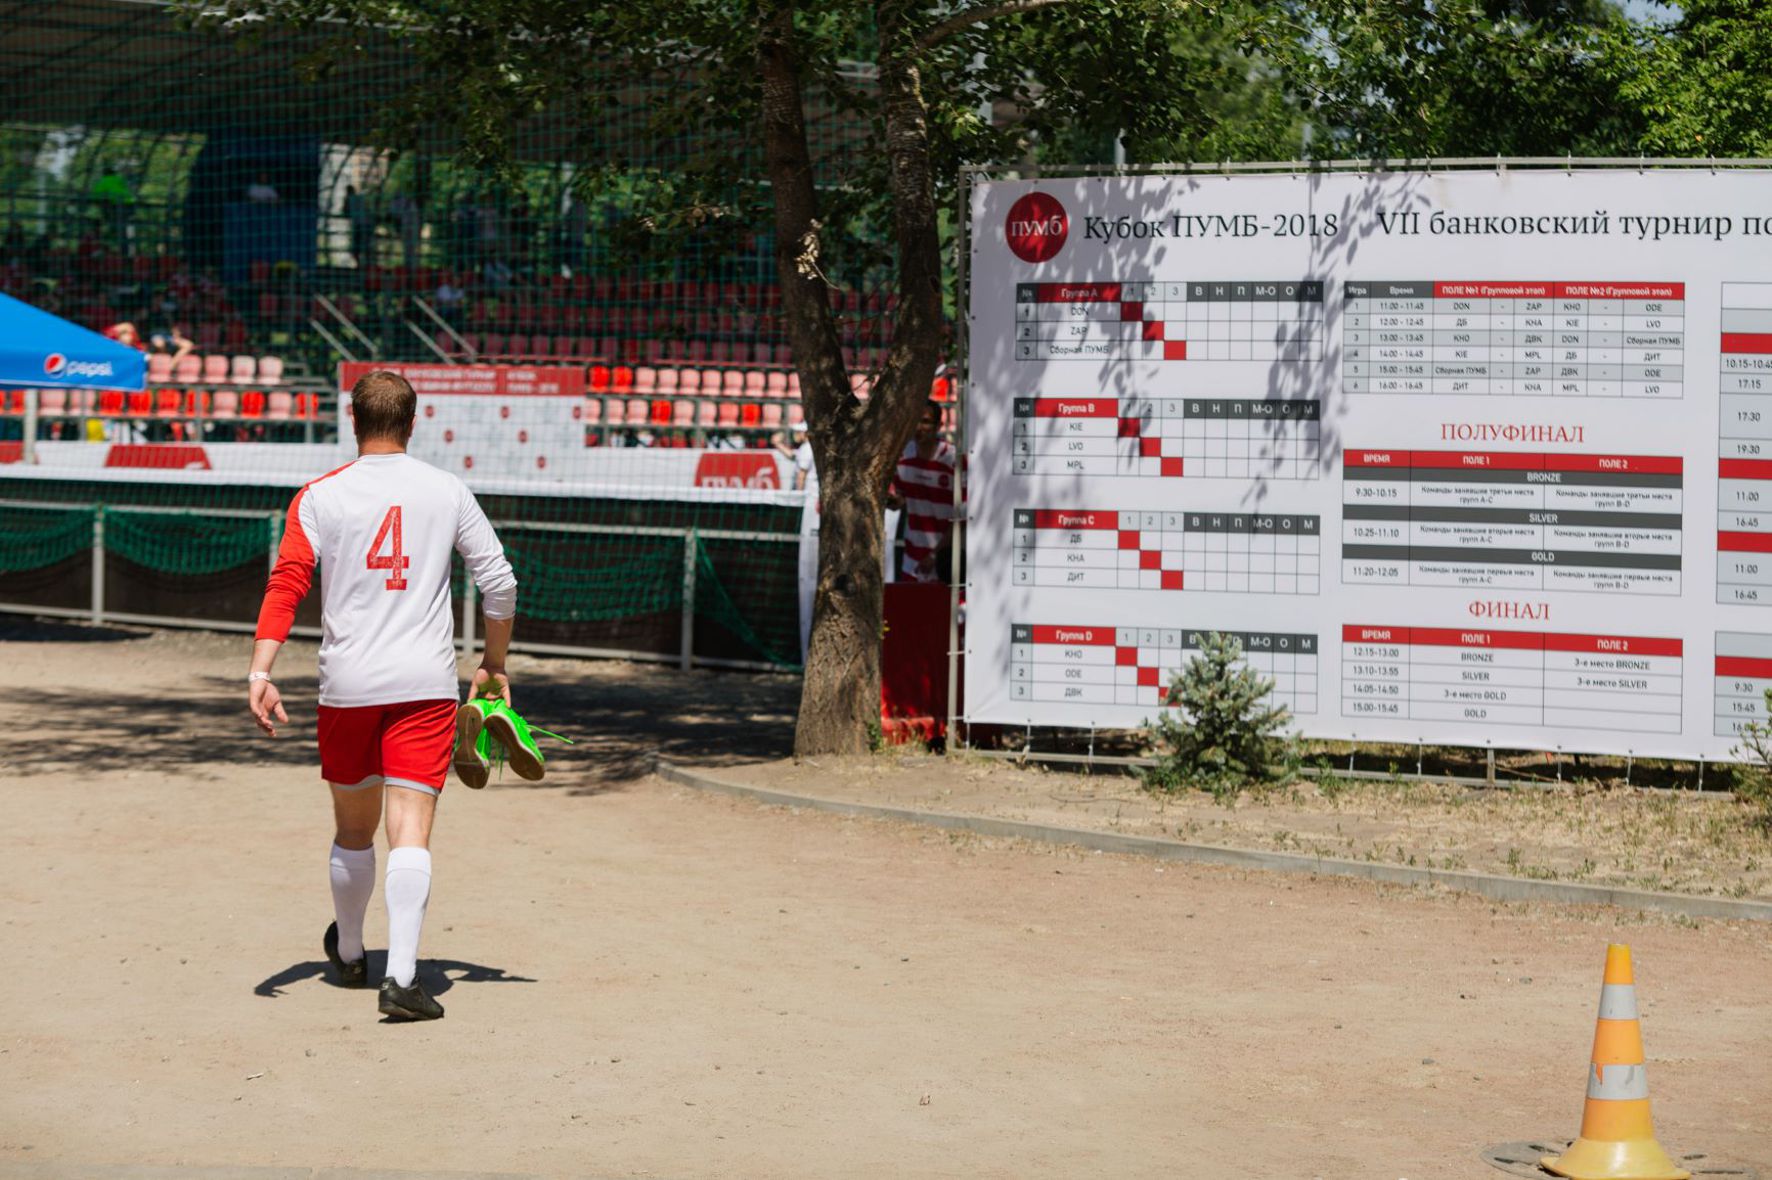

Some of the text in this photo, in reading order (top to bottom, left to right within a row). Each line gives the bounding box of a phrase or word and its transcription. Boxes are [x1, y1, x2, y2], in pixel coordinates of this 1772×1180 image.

[1085, 213, 1338, 243] Кубок ПУМБ-2018
[1376, 213, 1420, 235] VII
[1429, 210, 1609, 236] банковский
[1619, 216, 1733, 241] турнир
[1061, 288, 1089, 298] Группа
[1442, 286, 1464, 295] ПОЛЕ
[1566, 286, 1588, 295] ПОЛЕ
[67, 361, 113, 376] pepsi
[1059, 403, 1086, 414] Группа
[1070, 422, 1083, 431] KIE
[1441, 423, 1584, 443] ПОЛУФИНАЛ
[1363, 454, 1390, 463] ВРЕМЯ
[1463, 456, 1485, 465] ПОЛЕ
[1067, 461, 1084, 469] MPL
[1599, 459, 1628, 469] ПОЛЕ 2
[1527, 472, 1562, 483] BRONZE
[1058, 515, 1086, 526] Группа
[1127, 516, 1131, 524] 1
[1148, 516, 1153, 524] 2
[1170, 516, 1175, 524] 3
[1529, 513, 1558, 523] SILVER
[1070, 534, 1082, 544] ДБ
[366, 505, 409, 590] 4
[1021, 553, 1027, 562] 2
[1531, 552, 1555, 562] GOLD
[1021, 572, 1027, 580] 3
[1067, 573, 1084, 582] ДИТ
[1469, 600, 1549, 620] ФИНАЛ
[1056, 629, 1084, 642] Группа
[1124, 633, 1128, 643] 1
[1146, 633, 1152, 643] 2
[1168, 633, 1173, 643] 3
[1362, 629, 1391, 640] ВРЕМЯ
[1461, 634, 1485, 644] ПОЛЕ
[1597, 639, 1628, 650] ПОЛЕ 2
[1461, 652, 1494, 662] BRONZE
[1590, 660, 1614, 668] место
[1615, 661, 1650, 670] BRONZE
[1462, 672, 1490, 681] SILVER
[1593, 679, 1617, 687] место
[1619, 680, 1647, 689] SILVER
[1065, 688, 1082, 697] ДВК
[1484, 691, 1507, 700] GOLD
[1464, 709, 1487, 718] GOLD
